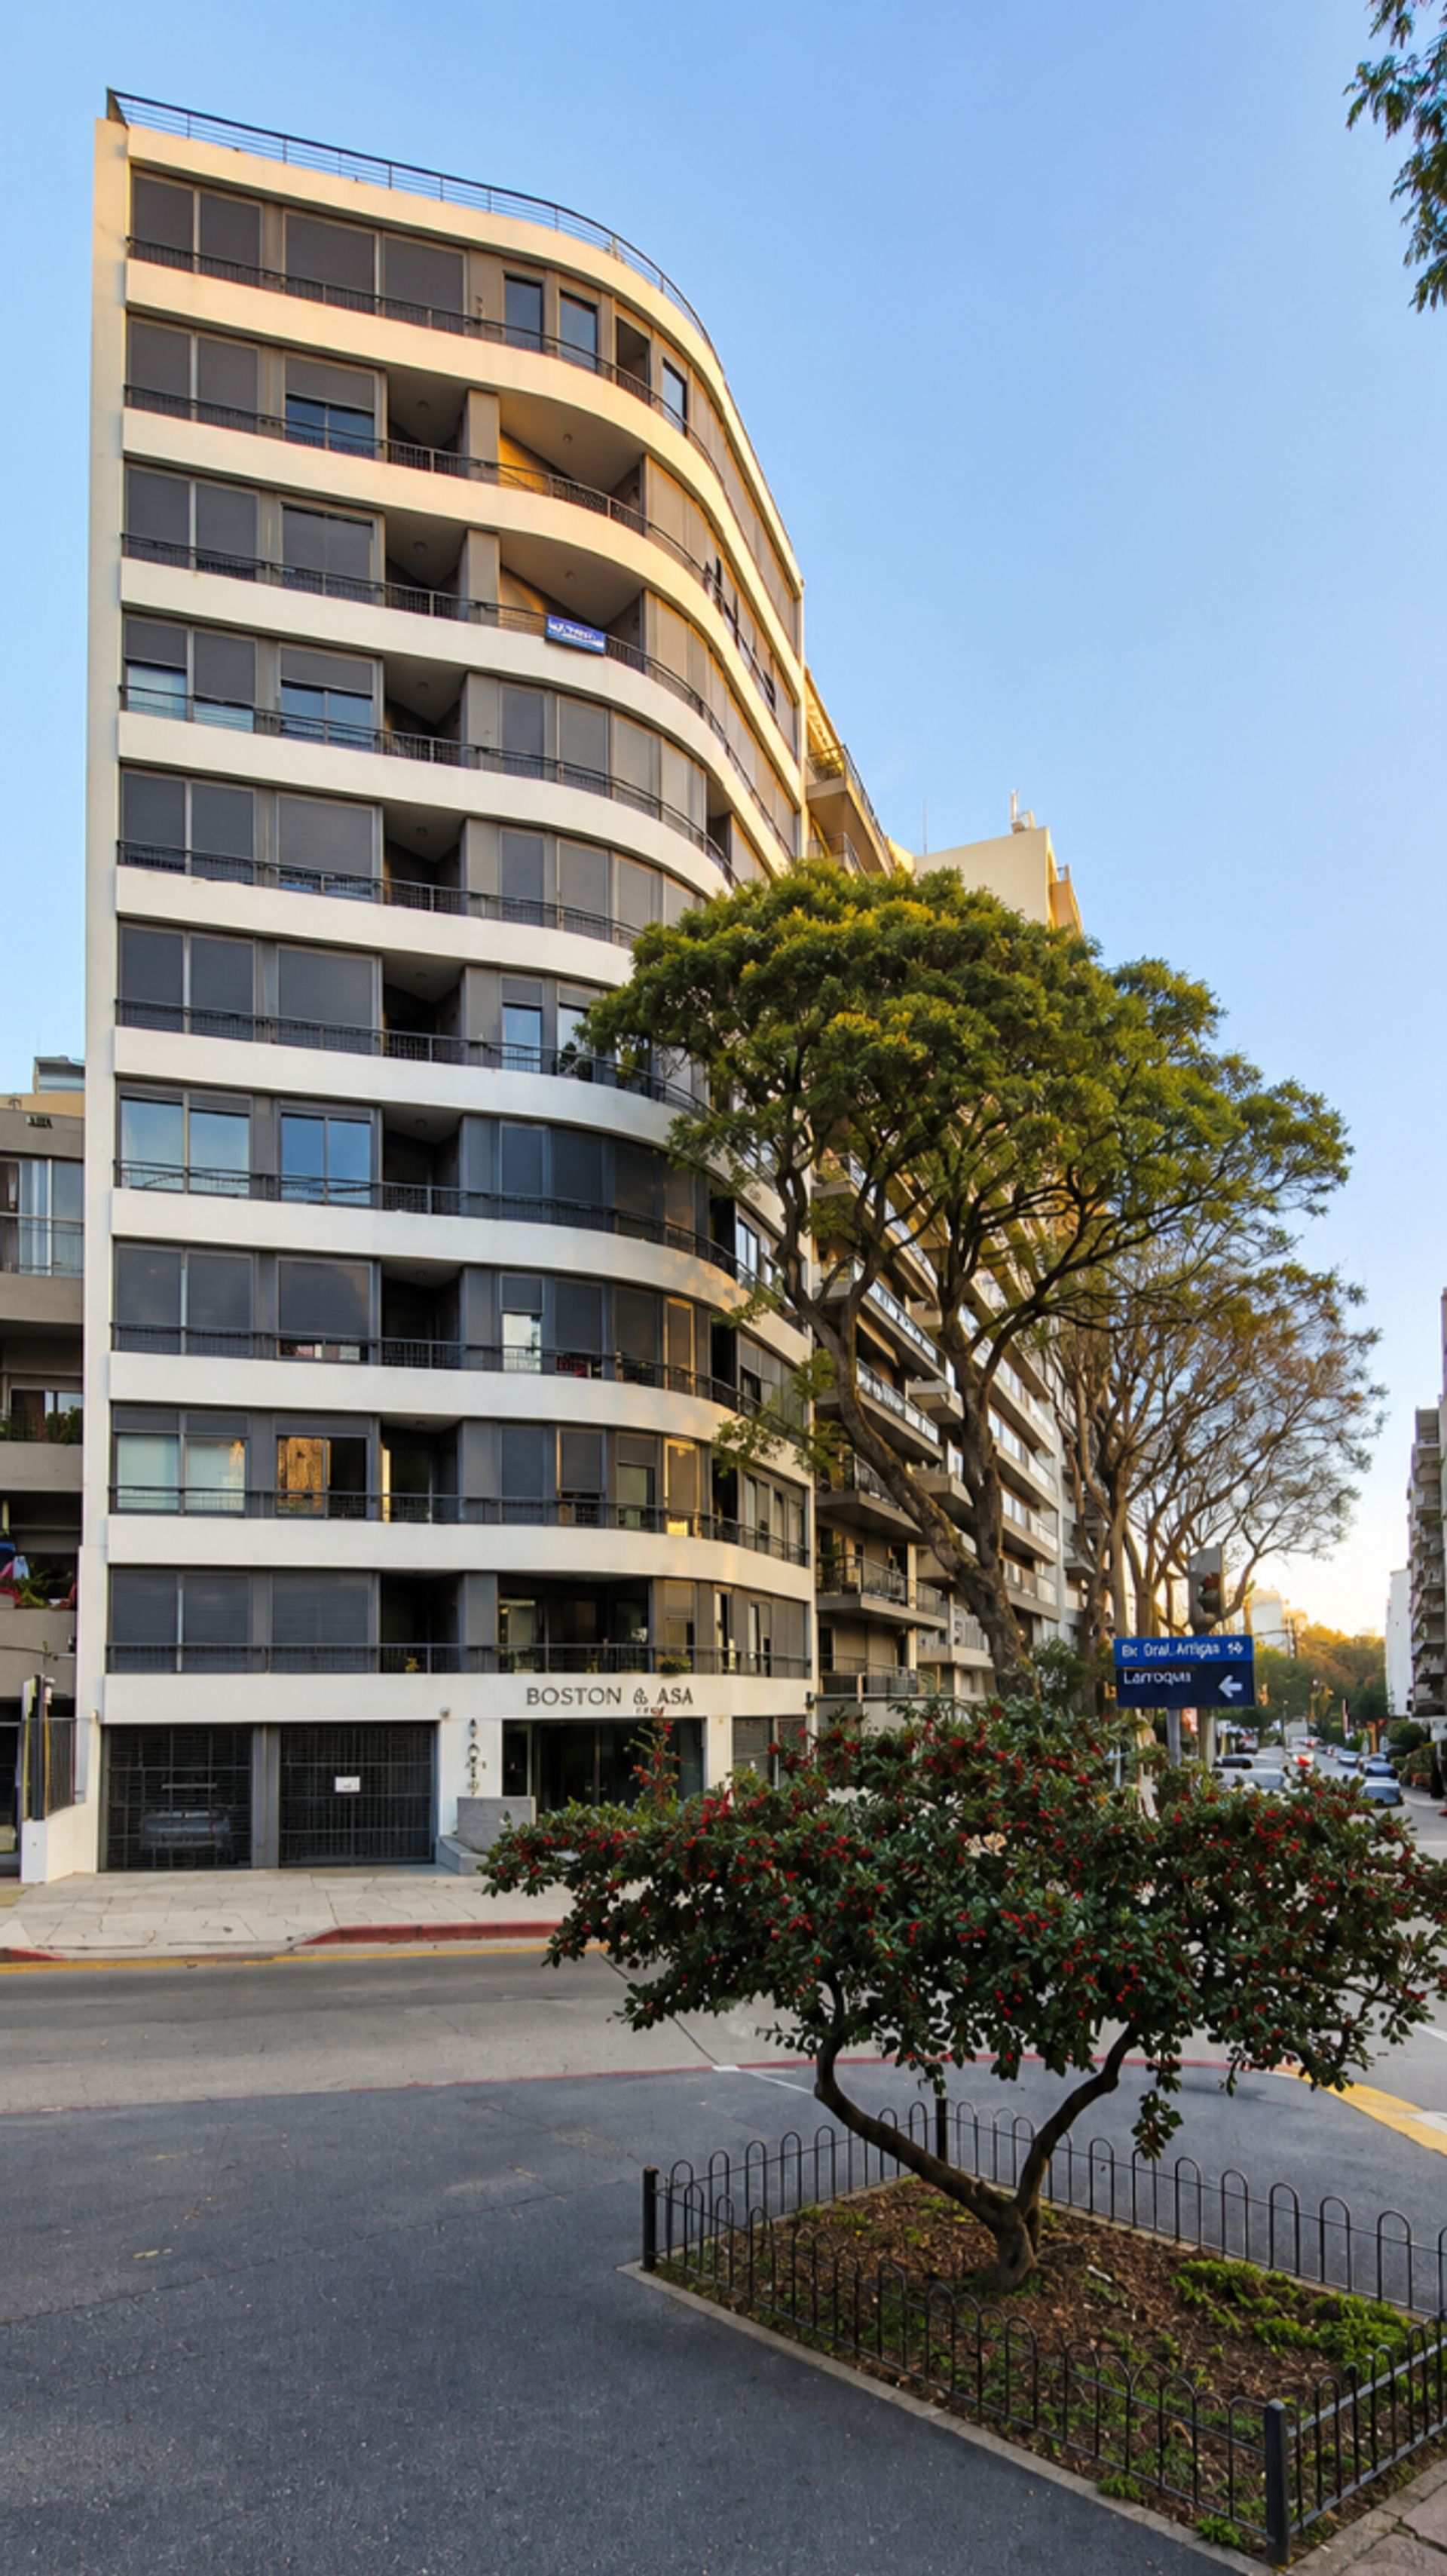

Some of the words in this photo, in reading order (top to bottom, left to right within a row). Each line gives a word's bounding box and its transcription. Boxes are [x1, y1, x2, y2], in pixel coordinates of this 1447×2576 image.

[526, 1686, 623, 1705] BOSTON
[633, 1687, 649, 1705] &
[656, 1687, 694, 1705] ASA
